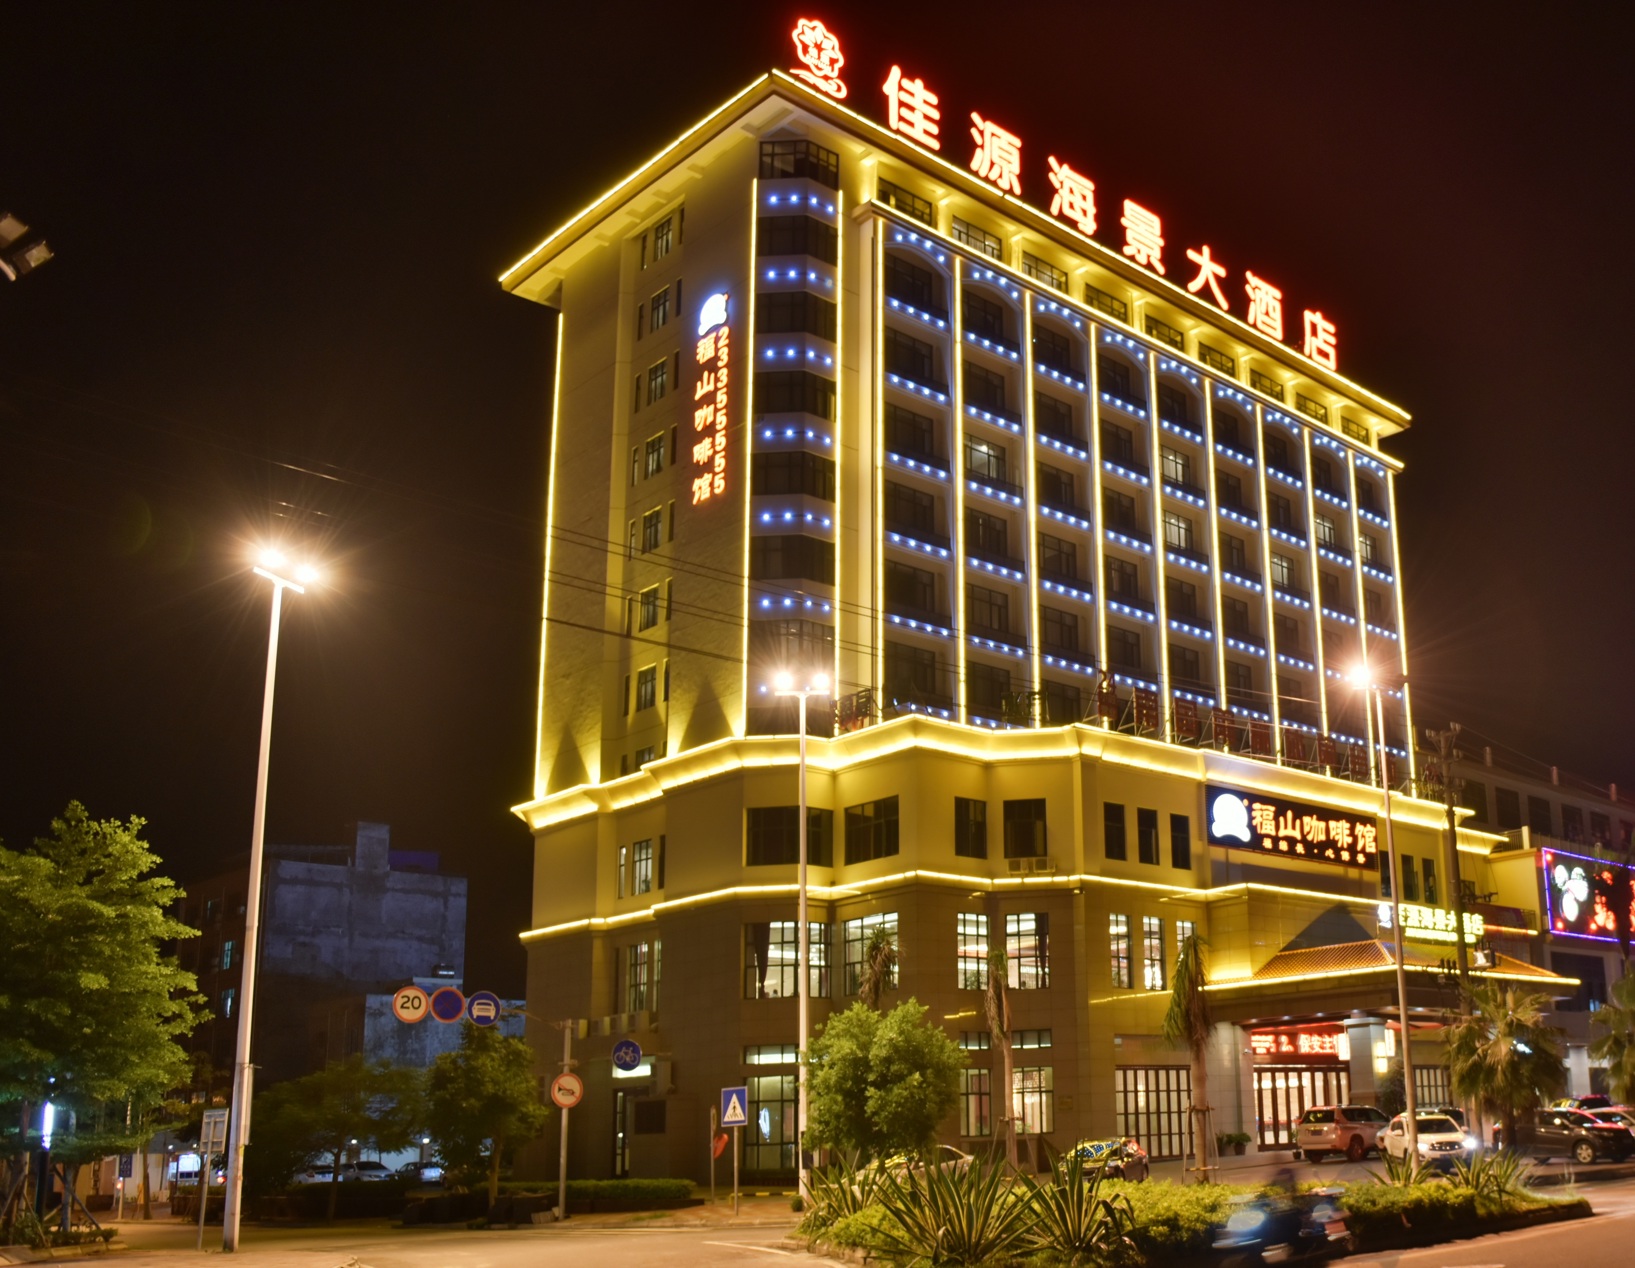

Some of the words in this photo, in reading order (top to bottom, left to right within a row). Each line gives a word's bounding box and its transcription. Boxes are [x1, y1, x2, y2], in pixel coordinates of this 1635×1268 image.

[882, 65, 1338, 371] 佳源海景大酒店
[692, 332, 716, 505] 福山咖啡馆
[712, 325, 730, 495] 23355555
[1251, 802, 1378, 853] 福山咖啡馆
[400, 995, 422, 1010] 20
